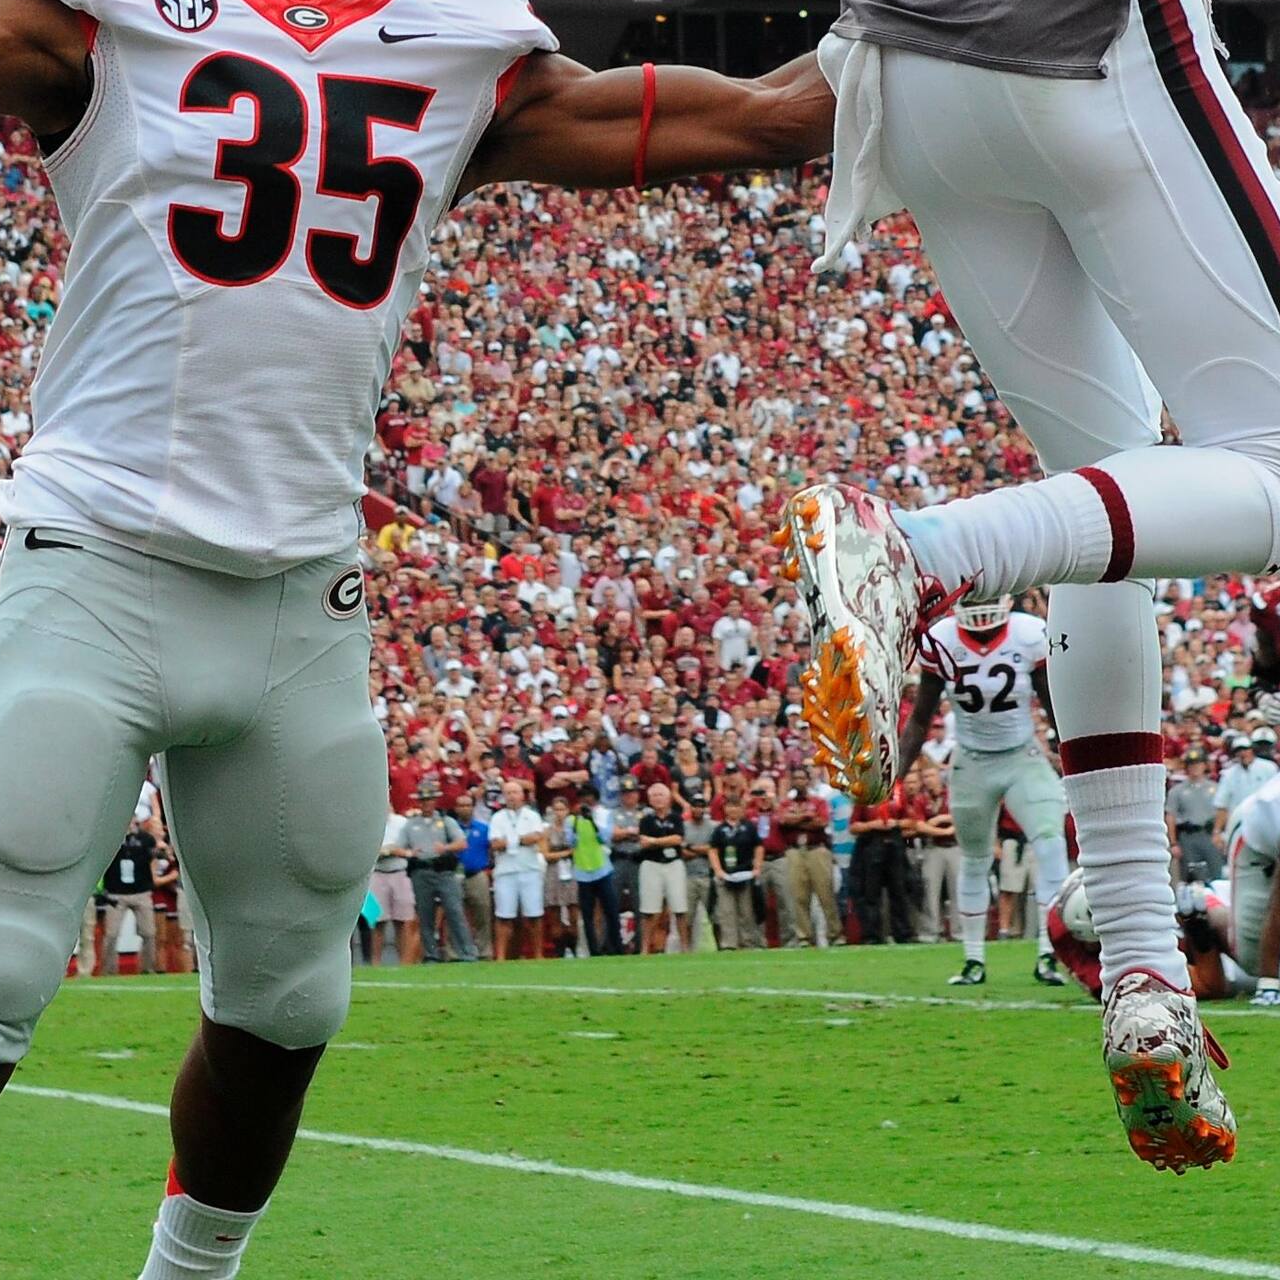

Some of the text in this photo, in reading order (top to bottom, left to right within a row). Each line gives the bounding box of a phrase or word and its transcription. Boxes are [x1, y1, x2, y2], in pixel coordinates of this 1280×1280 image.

[166, 49, 437, 311] 35
[329, 570, 363, 612] G
[954, 663, 1019, 714] 52
